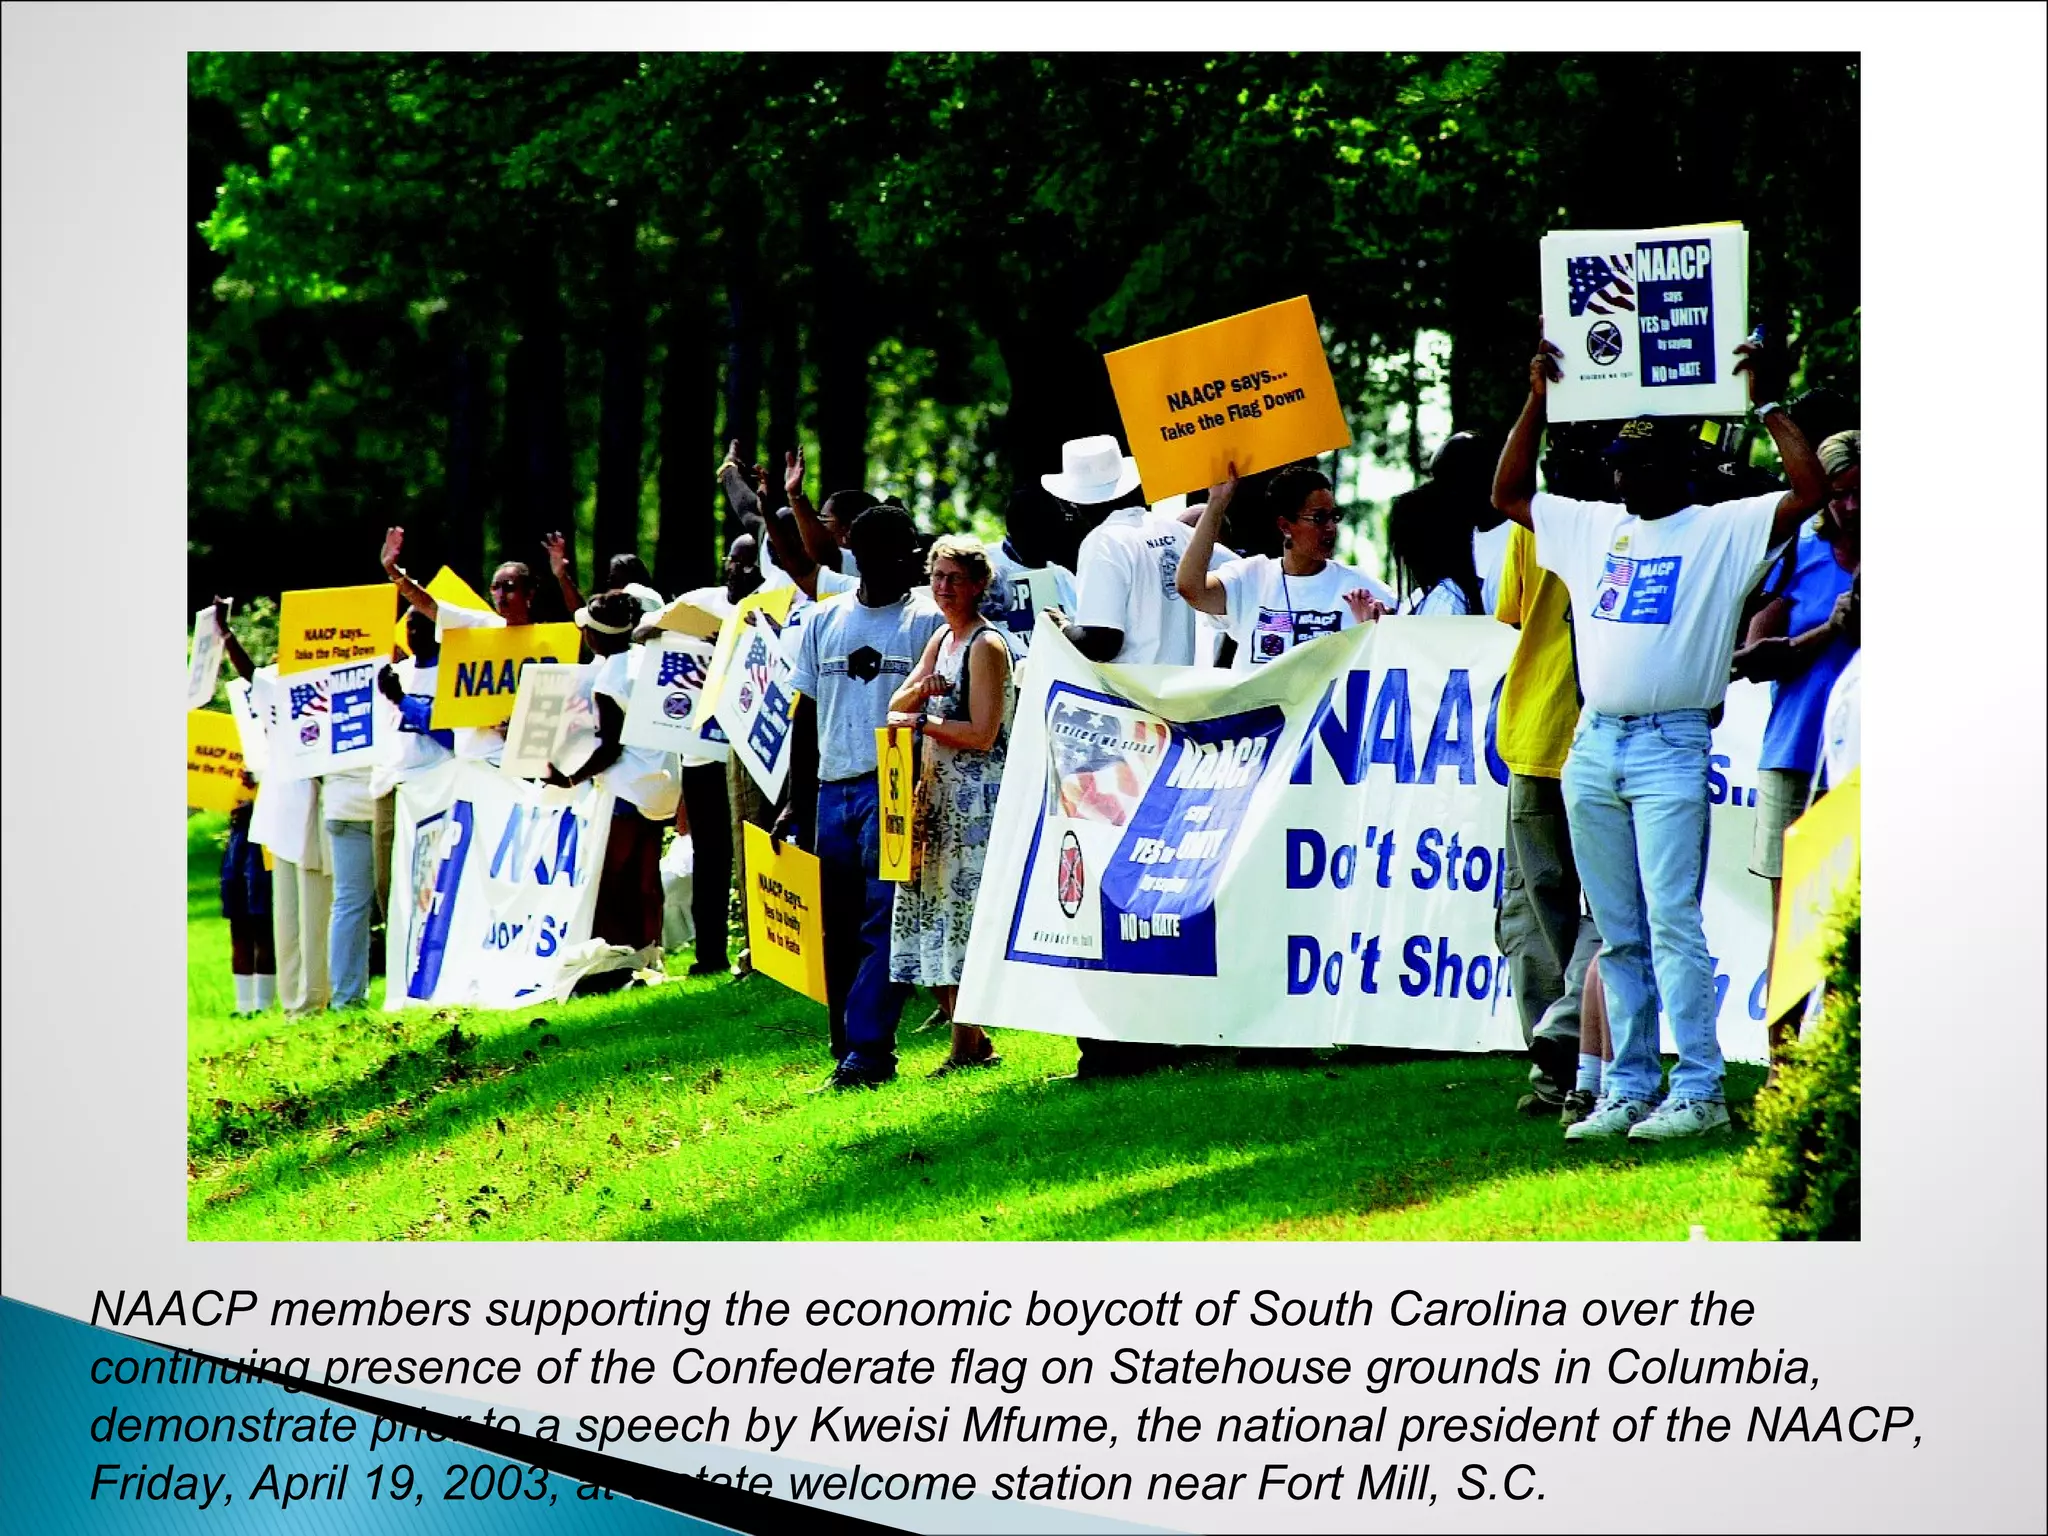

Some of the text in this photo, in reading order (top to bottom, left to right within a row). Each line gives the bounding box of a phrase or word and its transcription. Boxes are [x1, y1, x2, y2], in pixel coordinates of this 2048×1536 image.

[1637, 244, 1712, 283] NAACP
[1640, 316, 1660, 333] YES
[1670, 306, 1708, 328] UNITY
[1651, 365, 1668, 383] NO
[1166, 369, 1288, 413] NAACP says...
[1160, 387, 1305, 442] Take the Flag Down
[304, 627, 337, 641] NAACP
[454, 656, 559, 698] NAA
[1165, 736, 1268, 789] NAACP
[1128, 836, 1165, 865] YES
[758, 873, 783, 899] NAACP
[1119, 912, 1182, 942] NO to HATE
